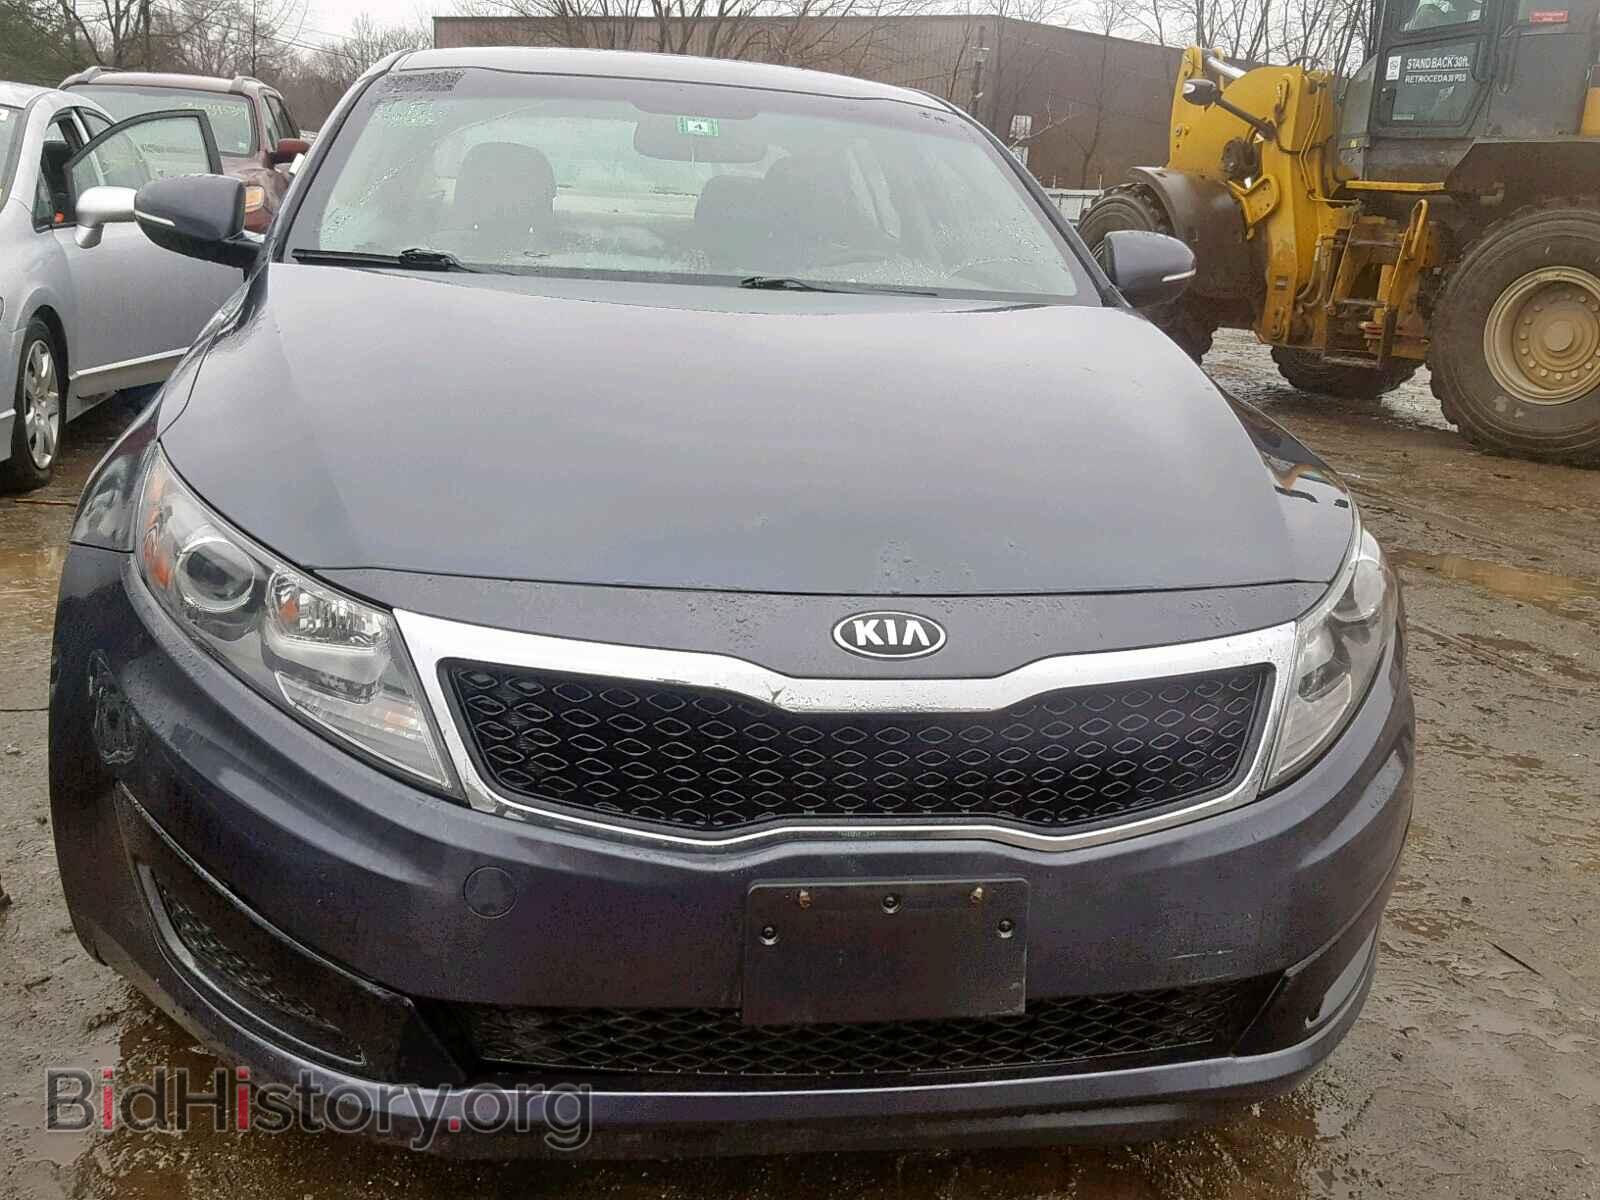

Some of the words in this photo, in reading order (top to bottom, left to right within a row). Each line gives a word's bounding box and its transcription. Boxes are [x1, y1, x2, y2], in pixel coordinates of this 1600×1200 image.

[1407, 58, 1431, 69] STAND
[1431, 57, 1453, 68] BACK
[853, 619, 930, 646] KIA
